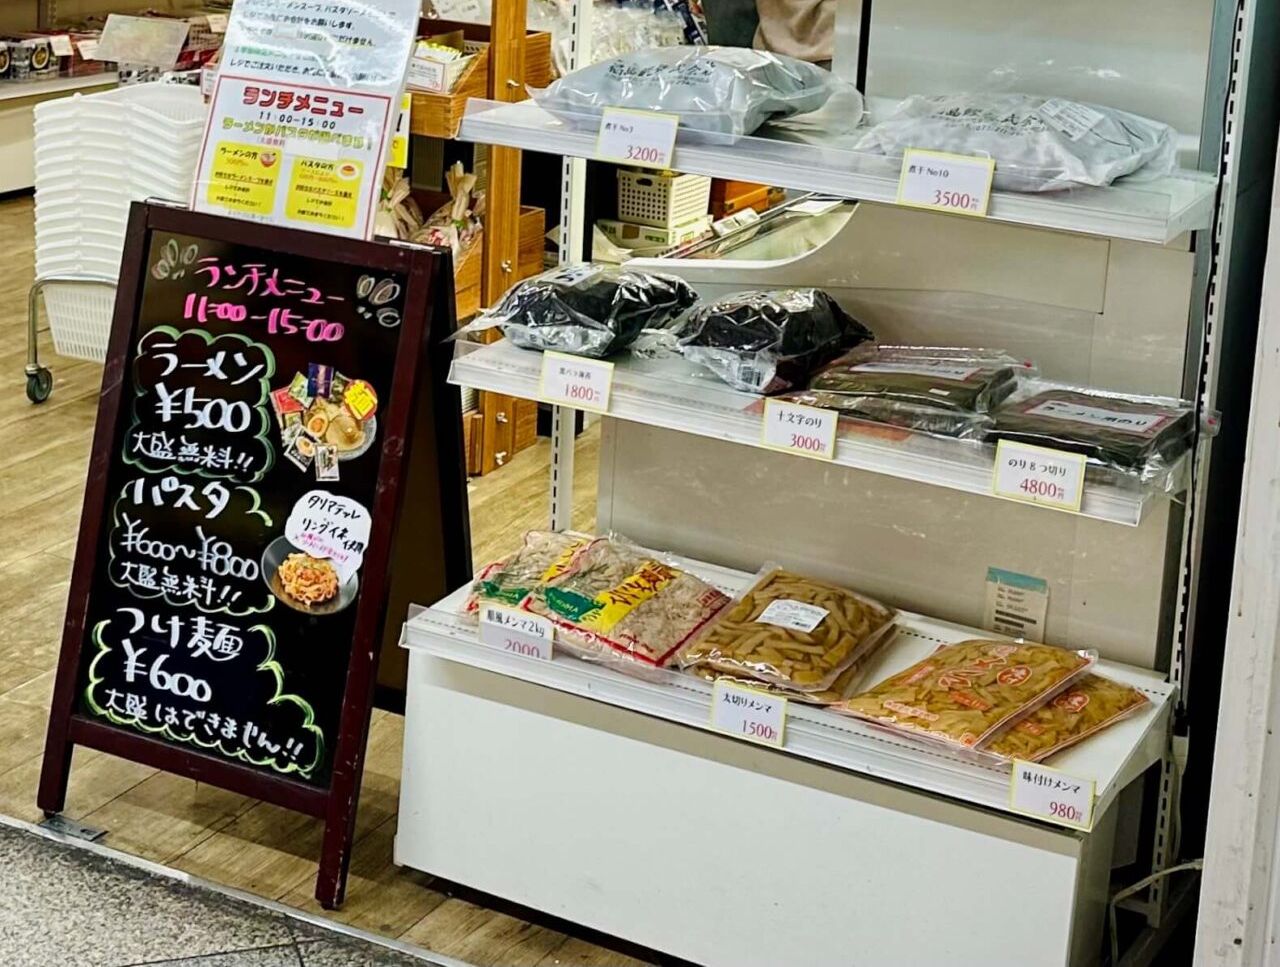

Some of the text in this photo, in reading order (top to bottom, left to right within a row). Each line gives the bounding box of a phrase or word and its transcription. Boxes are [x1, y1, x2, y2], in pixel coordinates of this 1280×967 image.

[243, 86, 364, 118] ランチメニュー
[195, 256, 345, 304] ランチメニュー
[151, 343, 264, 385] ラーメン
[776, 410, 823, 429] 十文字のり
[134, 476, 230, 519] パスタ
[117, 607, 244, 662] つけ麺
[723, 692, 772, 715] 太切りメンマ
[1023, 771, 1081, 795] 味付けメンマ
